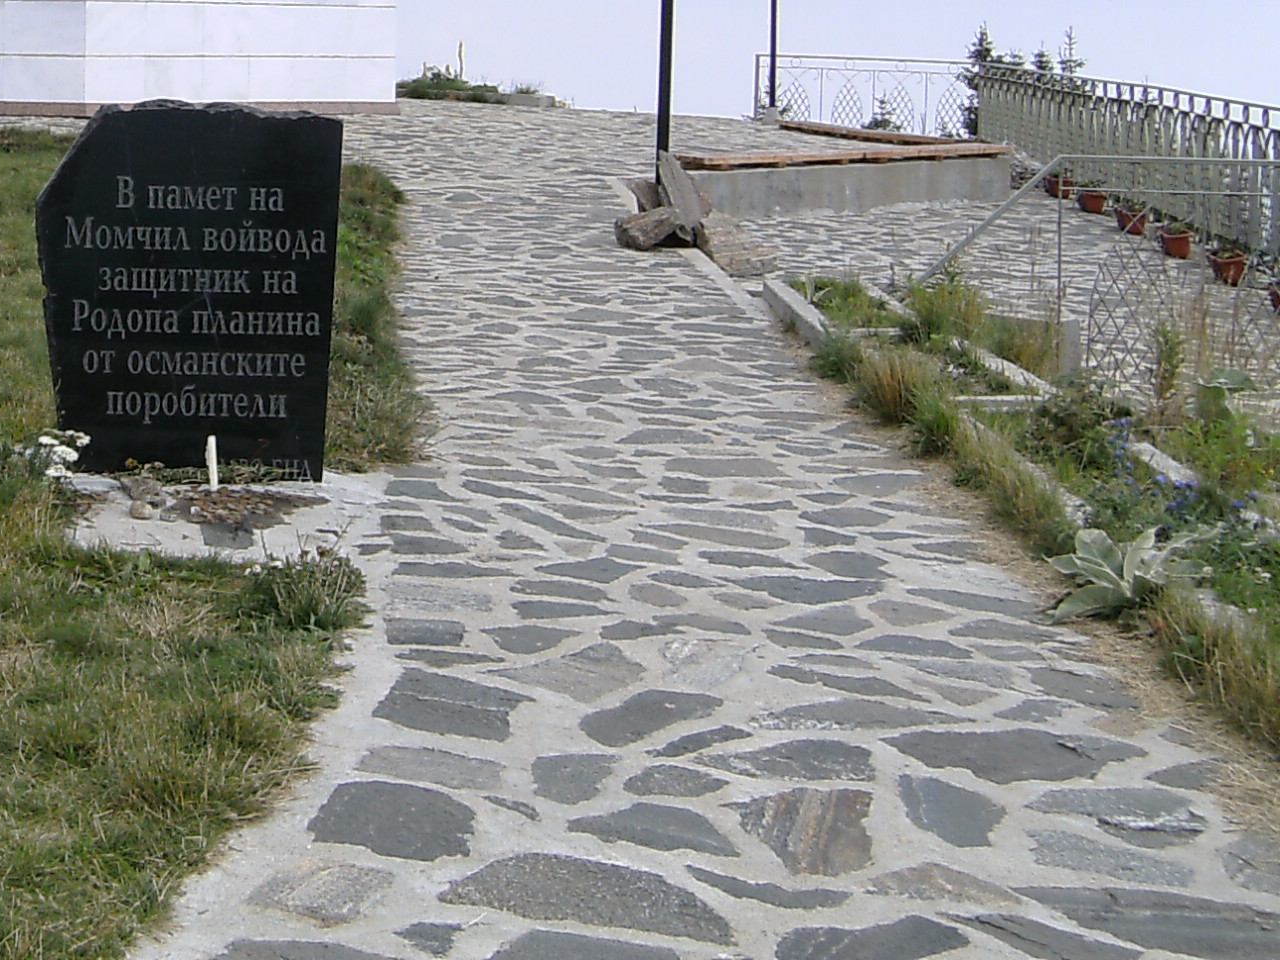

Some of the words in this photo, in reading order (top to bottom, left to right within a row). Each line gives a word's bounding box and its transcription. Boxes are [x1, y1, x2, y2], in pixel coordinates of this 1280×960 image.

[116, 175, 135, 208] В
[148, 185, 237, 211] памет
[249, 187, 284, 212] на
[64, 216, 191, 251] Момчил
[202, 220, 327, 260] войвода
[98, 267, 251, 299] защитник
[262, 270, 298, 295] на
[72, 299, 179, 340] Родопа
[191, 306, 320, 336] планина
[82, 350, 115, 374] от
[127, 350, 306, 377] османските
[106, 385, 287, 424] поробители
